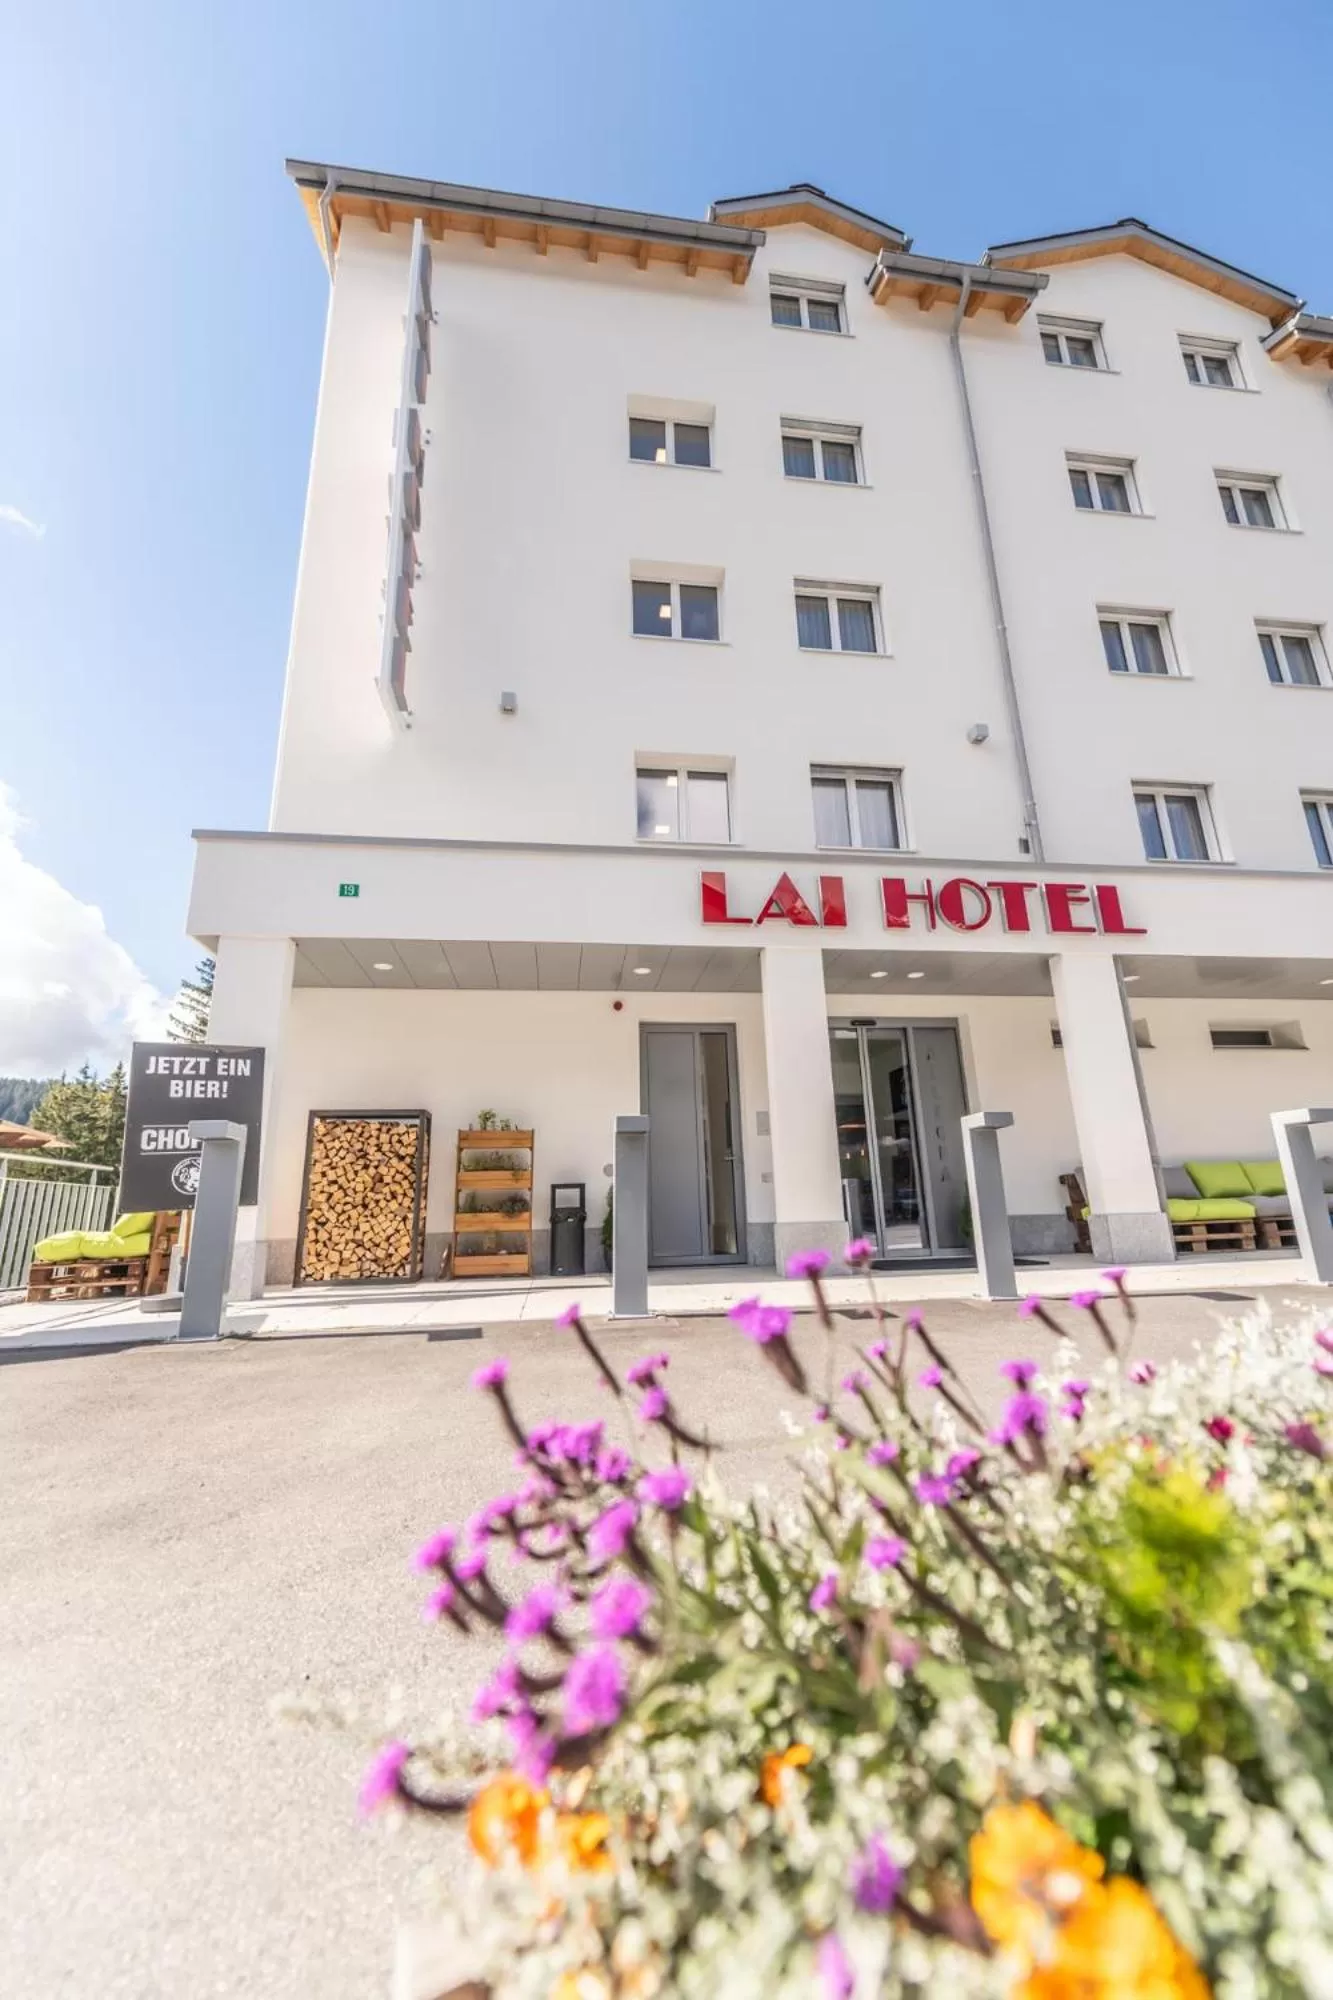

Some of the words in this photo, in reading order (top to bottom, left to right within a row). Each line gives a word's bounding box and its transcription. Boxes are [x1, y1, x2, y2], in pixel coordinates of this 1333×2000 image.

[344, 884, 355, 896] 19
[701, 871, 848, 928] LAI
[881, 877, 1148, 934] HOTEL
[145, 1056, 211, 1075] JETZT
[217, 1058, 251, 1077] EIN
[169, 1079, 229, 1098] BIER!
